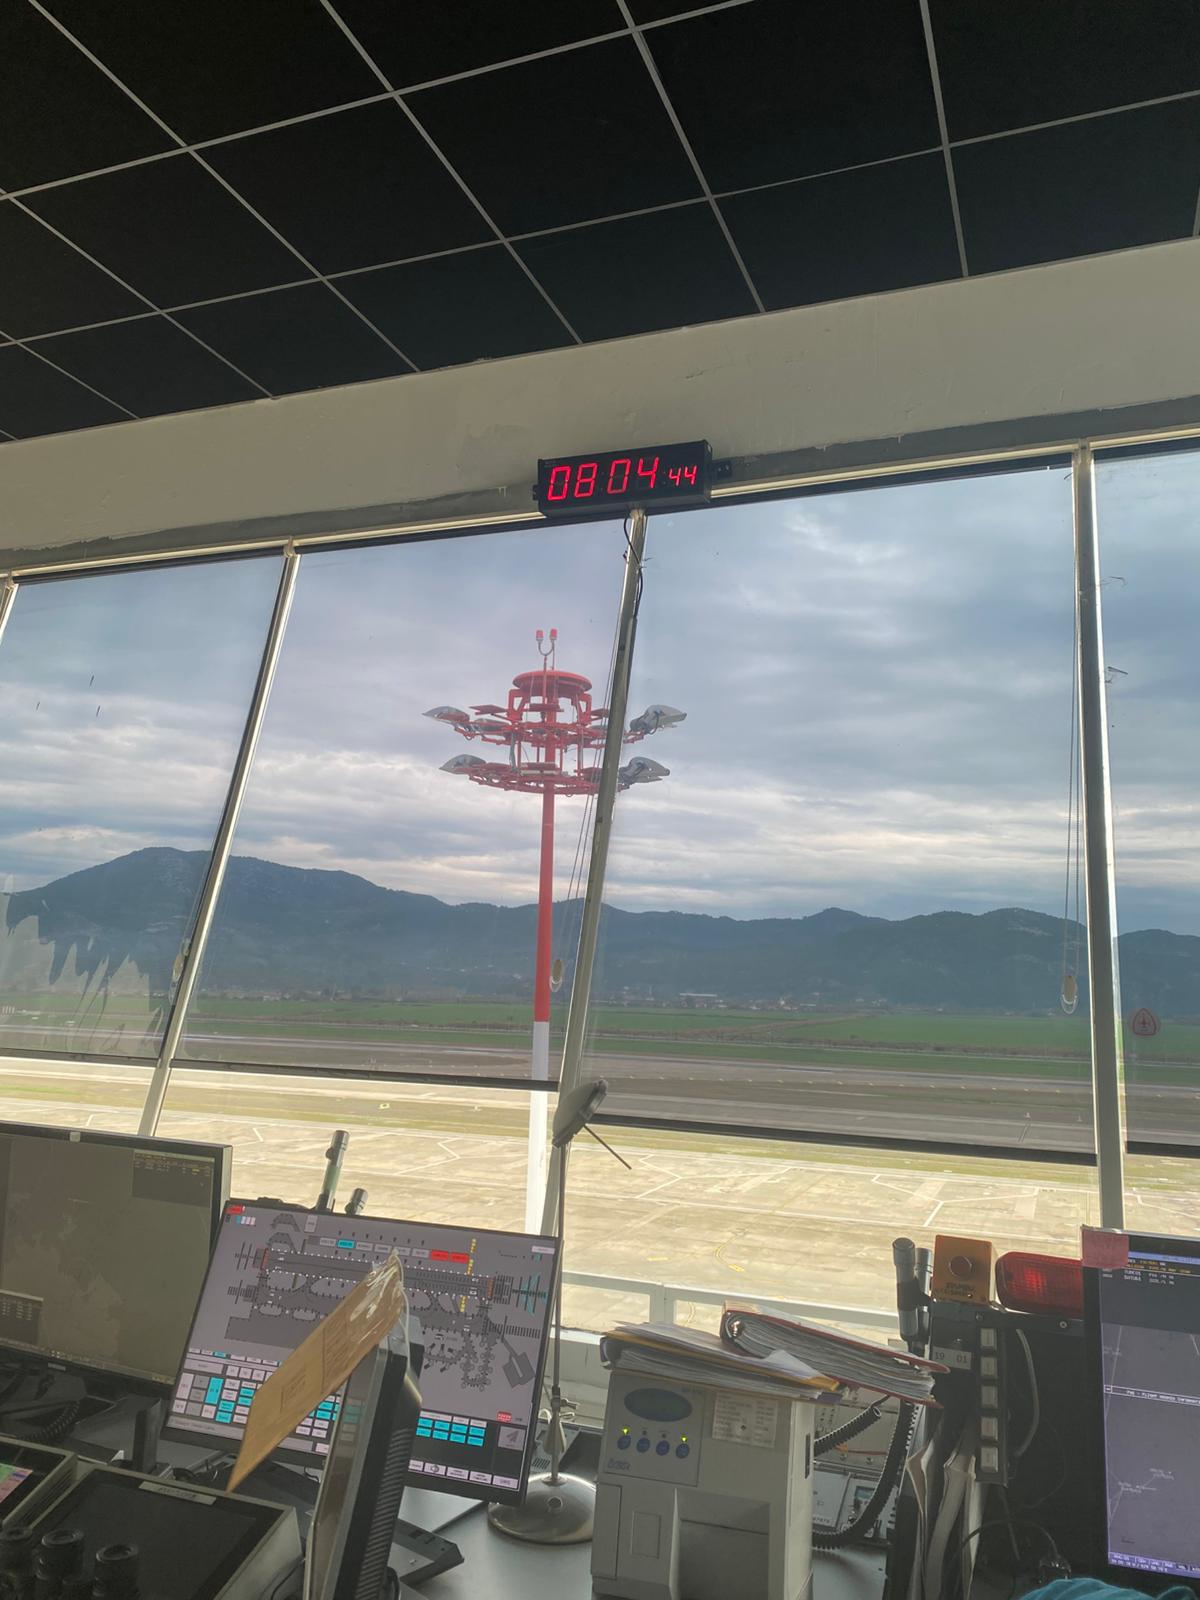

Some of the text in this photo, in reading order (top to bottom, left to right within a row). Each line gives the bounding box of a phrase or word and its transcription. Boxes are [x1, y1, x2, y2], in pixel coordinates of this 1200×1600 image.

[547, 456, 698, 500] 08 04 44
[935, 1351, 945, 1360] 19
